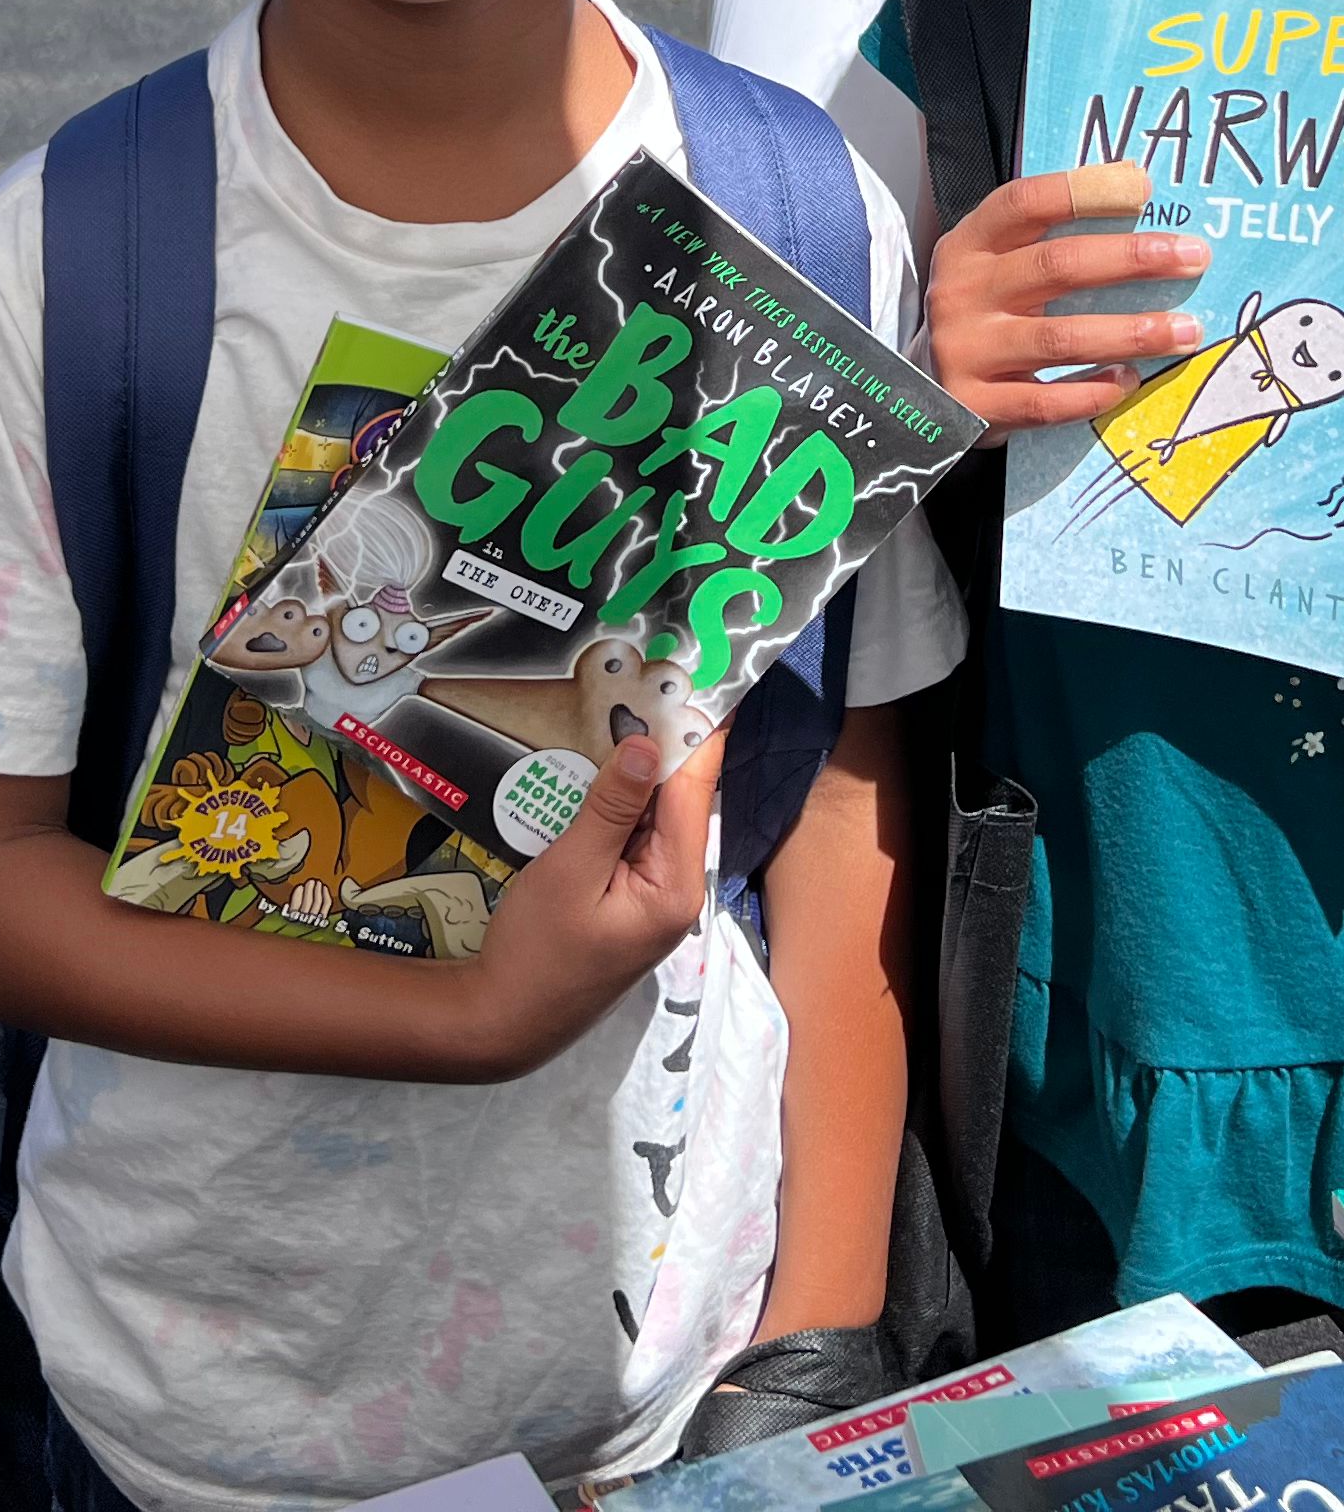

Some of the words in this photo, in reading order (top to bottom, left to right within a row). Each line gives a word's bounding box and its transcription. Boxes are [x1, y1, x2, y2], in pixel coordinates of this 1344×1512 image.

[1140, 201, 1192, 227] AND
[1203, 196, 1334, 247] JELLY
[532, 307, 597, 370] the
[636, 202, 665, 224] #1
[664, 221, 706, 255] NEW
[702, 251, 747, 290] YORK
[745, 287, 796, 329] TIMES
[792, 321, 892, 403] BESTSELLING
[889, 397, 944, 443] SERIES
[361, 400, 419, 468] GUYS
[557, 302, 856, 560] BAD
[414, 389, 784, 690] GUYS
[482, 540, 504, 561] in
[1111, 547, 1185, 584] BEN
[456, 560, 501, 591] THE
[509, 584, 574, 622] ONE?!
[355, 725, 464, 807] SCHOLASTIC
[526, 759, 583, 805] MAJO
[195, 789, 272, 819] POSSIBLE
[209, 810, 248, 841] 14
[504, 789, 564, 836] PICTUR
[515, 774, 578, 824] MOTIO
[189, 837, 261, 864] ENDINGS
[258, 897, 278, 915] by
[281, 902, 330, 929] Laurie
[334, 919, 351, 936] S.
[357, 926, 414, 955] Sutton
[814, 1377, 984, 1449] SCHLASTIC
[1036, 1416, 1197, 1475] SCHOLASTIC
[1115, 1422, 1249, 1504] THOMAS
[860, 1469, 893, 1490] BY
